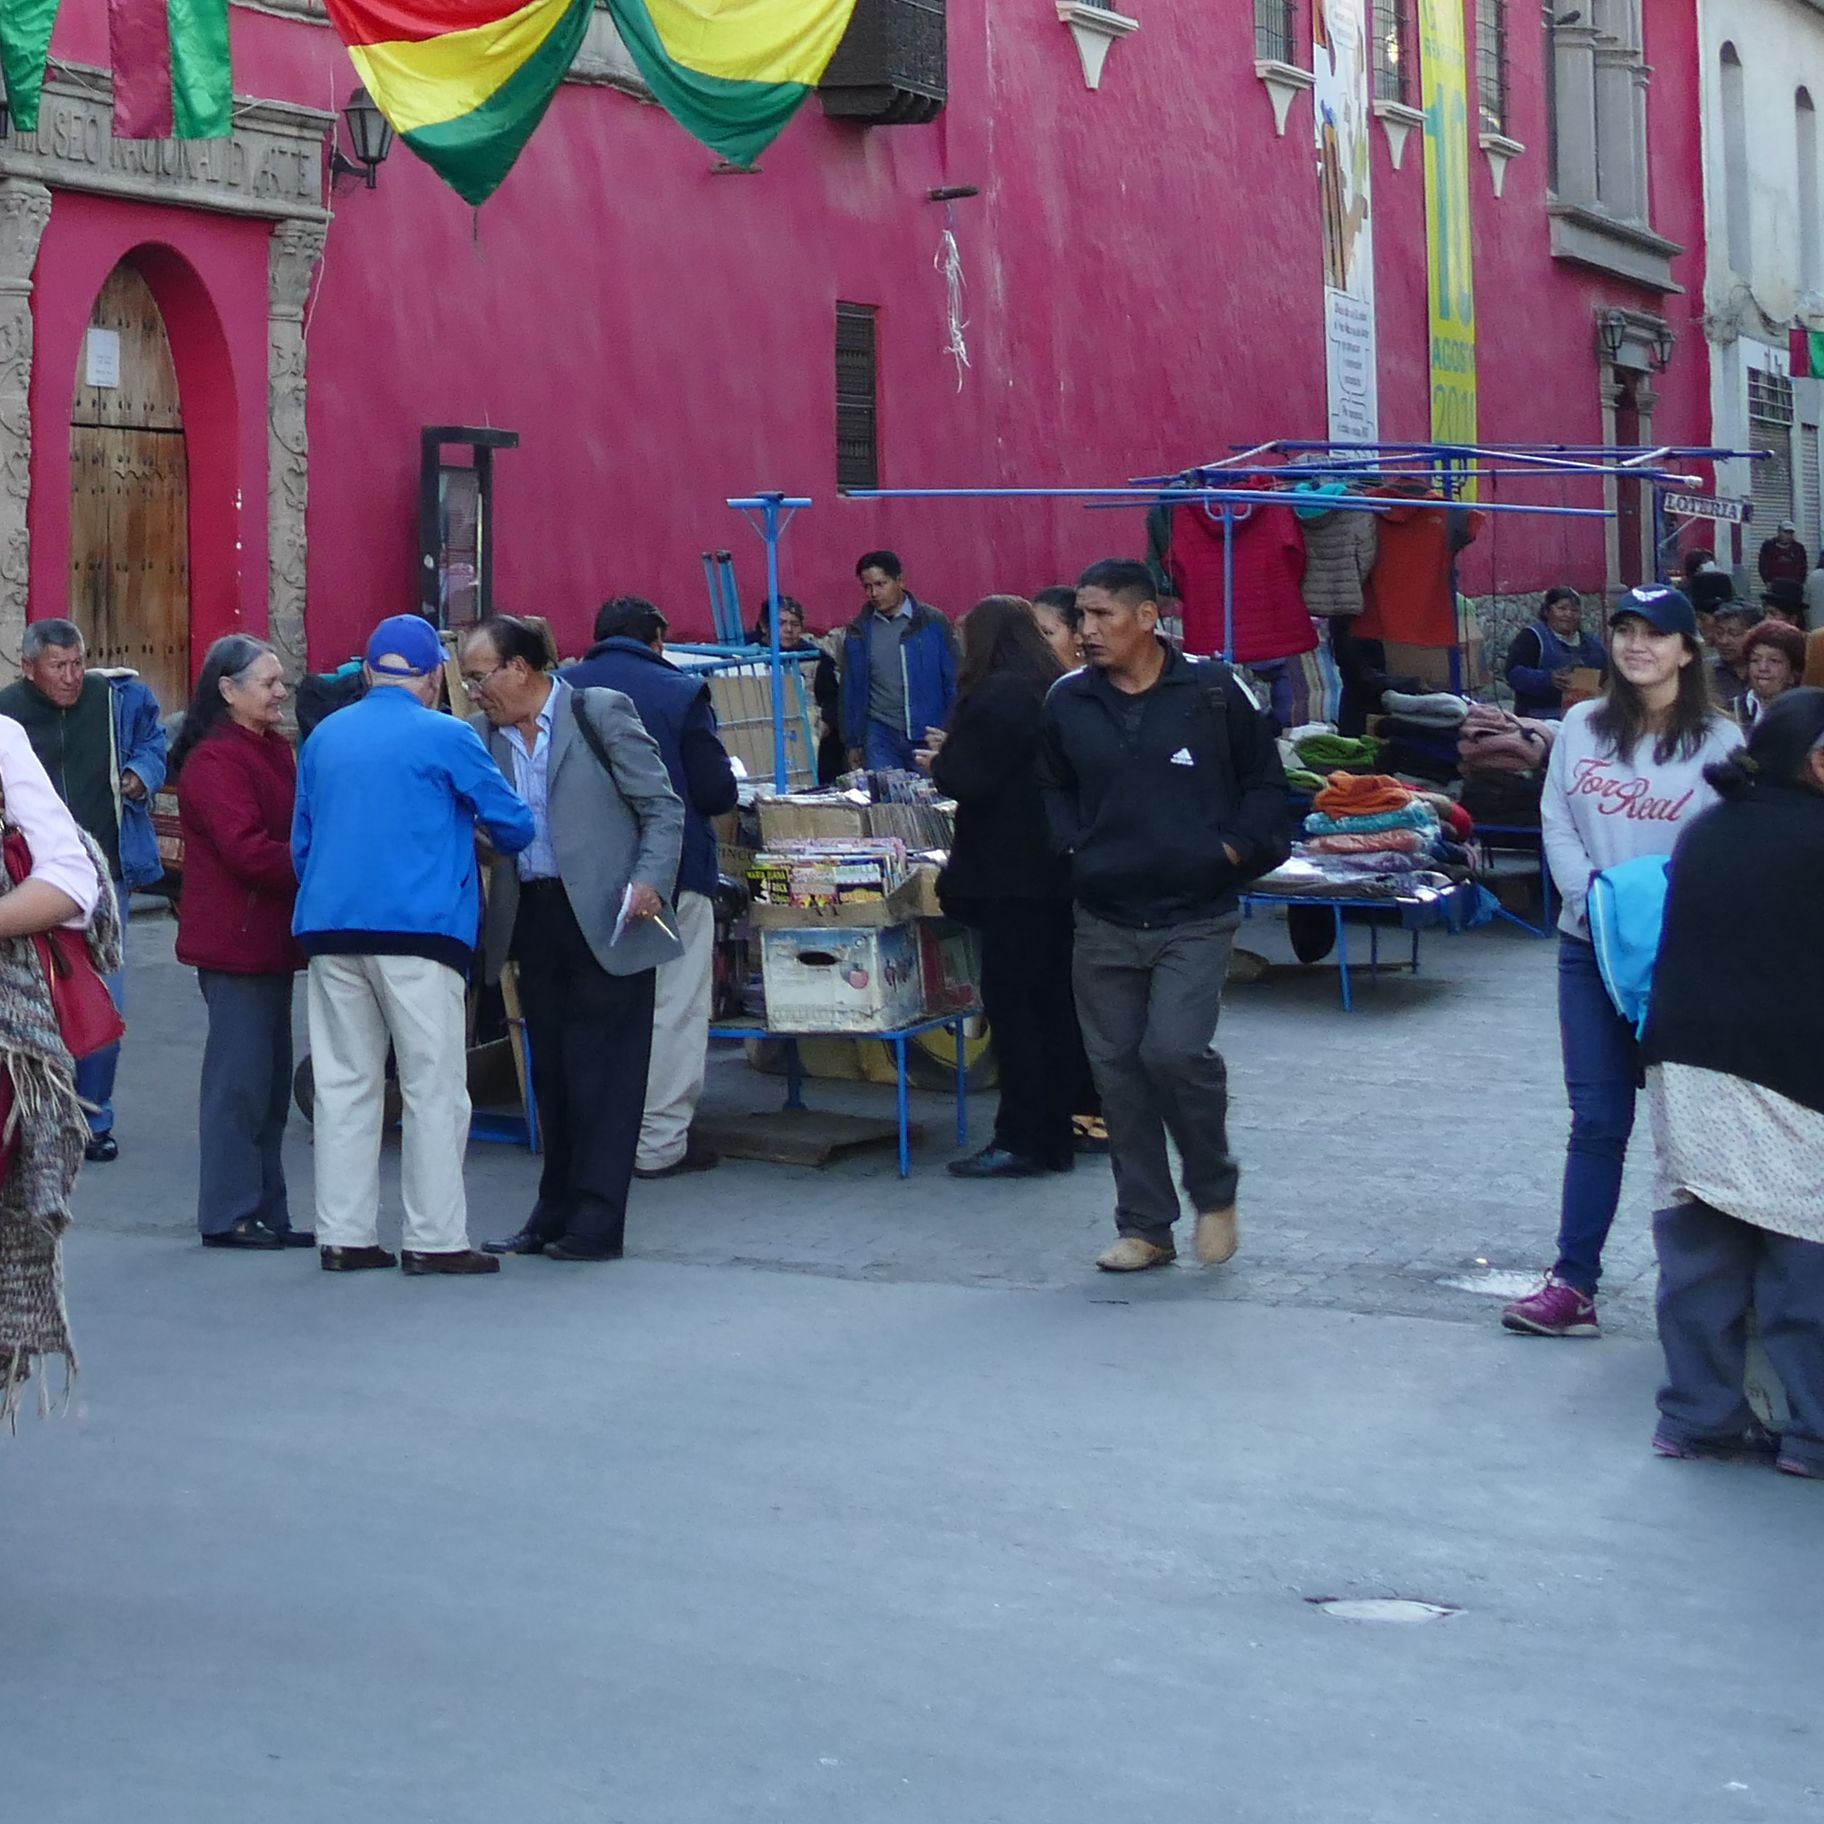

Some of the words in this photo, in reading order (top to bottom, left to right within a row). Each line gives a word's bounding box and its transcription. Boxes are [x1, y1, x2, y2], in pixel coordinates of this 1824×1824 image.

[1666, 495, 1738, 521] LOTERIA
[1567, 758, 1620, 797] For
[1598, 777, 1694, 822] Real
